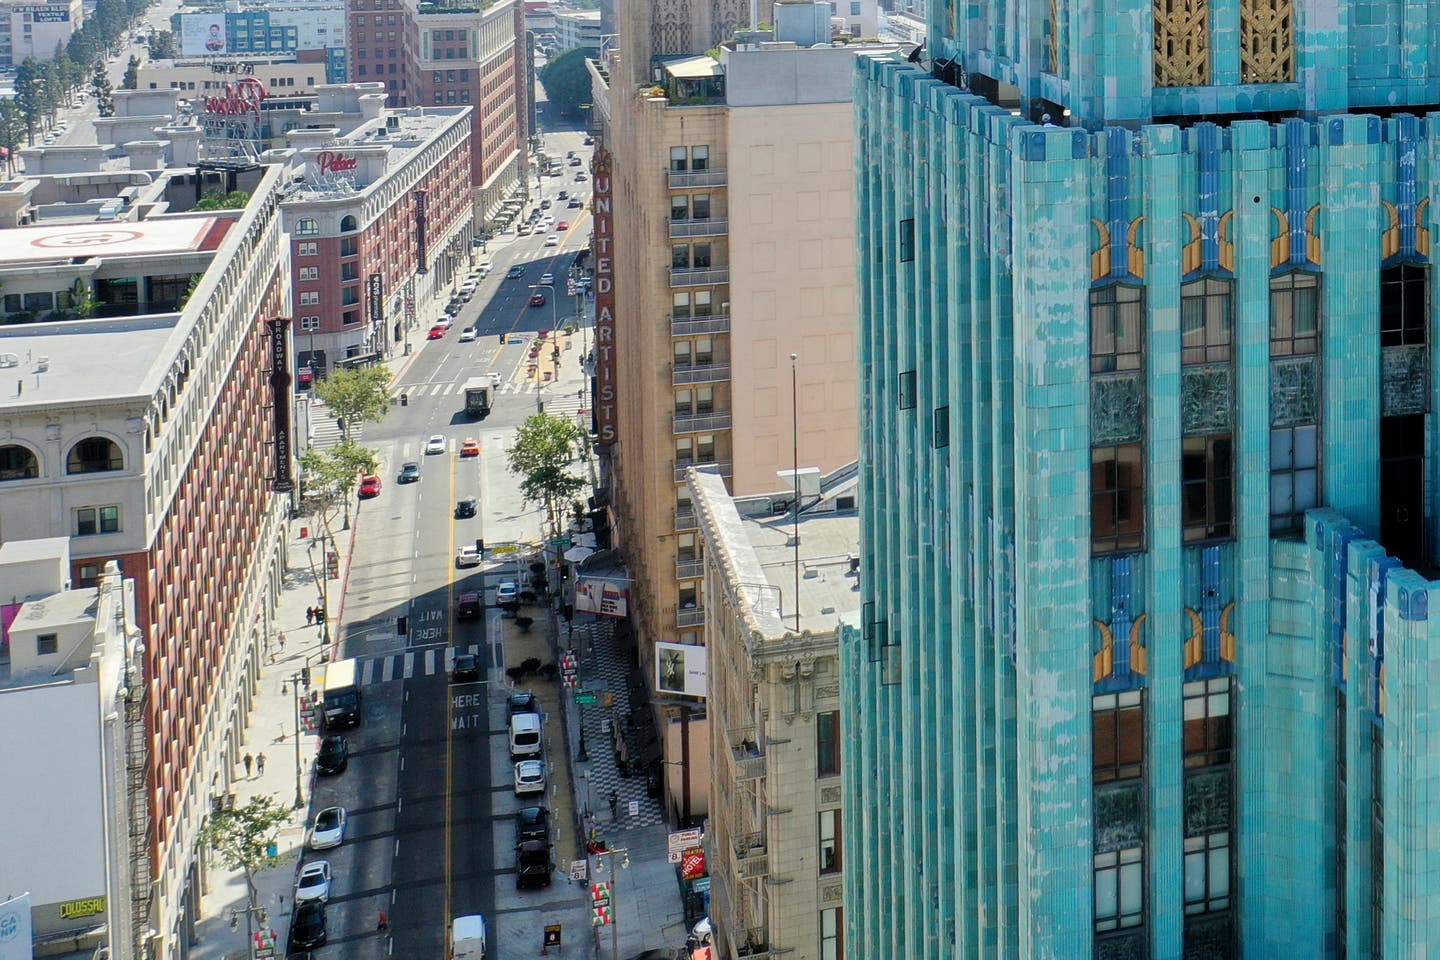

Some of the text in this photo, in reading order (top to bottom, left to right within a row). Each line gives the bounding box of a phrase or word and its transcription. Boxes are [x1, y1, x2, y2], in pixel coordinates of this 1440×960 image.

[317, 151, 358, 176] Palace
[597, 178, 612, 294] UNITED
[275, 320, 284, 372] BROADWAY
[598, 306, 615, 441] ARTISTS
[416, 627, 442, 640] HERE
[452, 693, 480, 708] HERE
[682, 856, 703, 875] HOTEL
